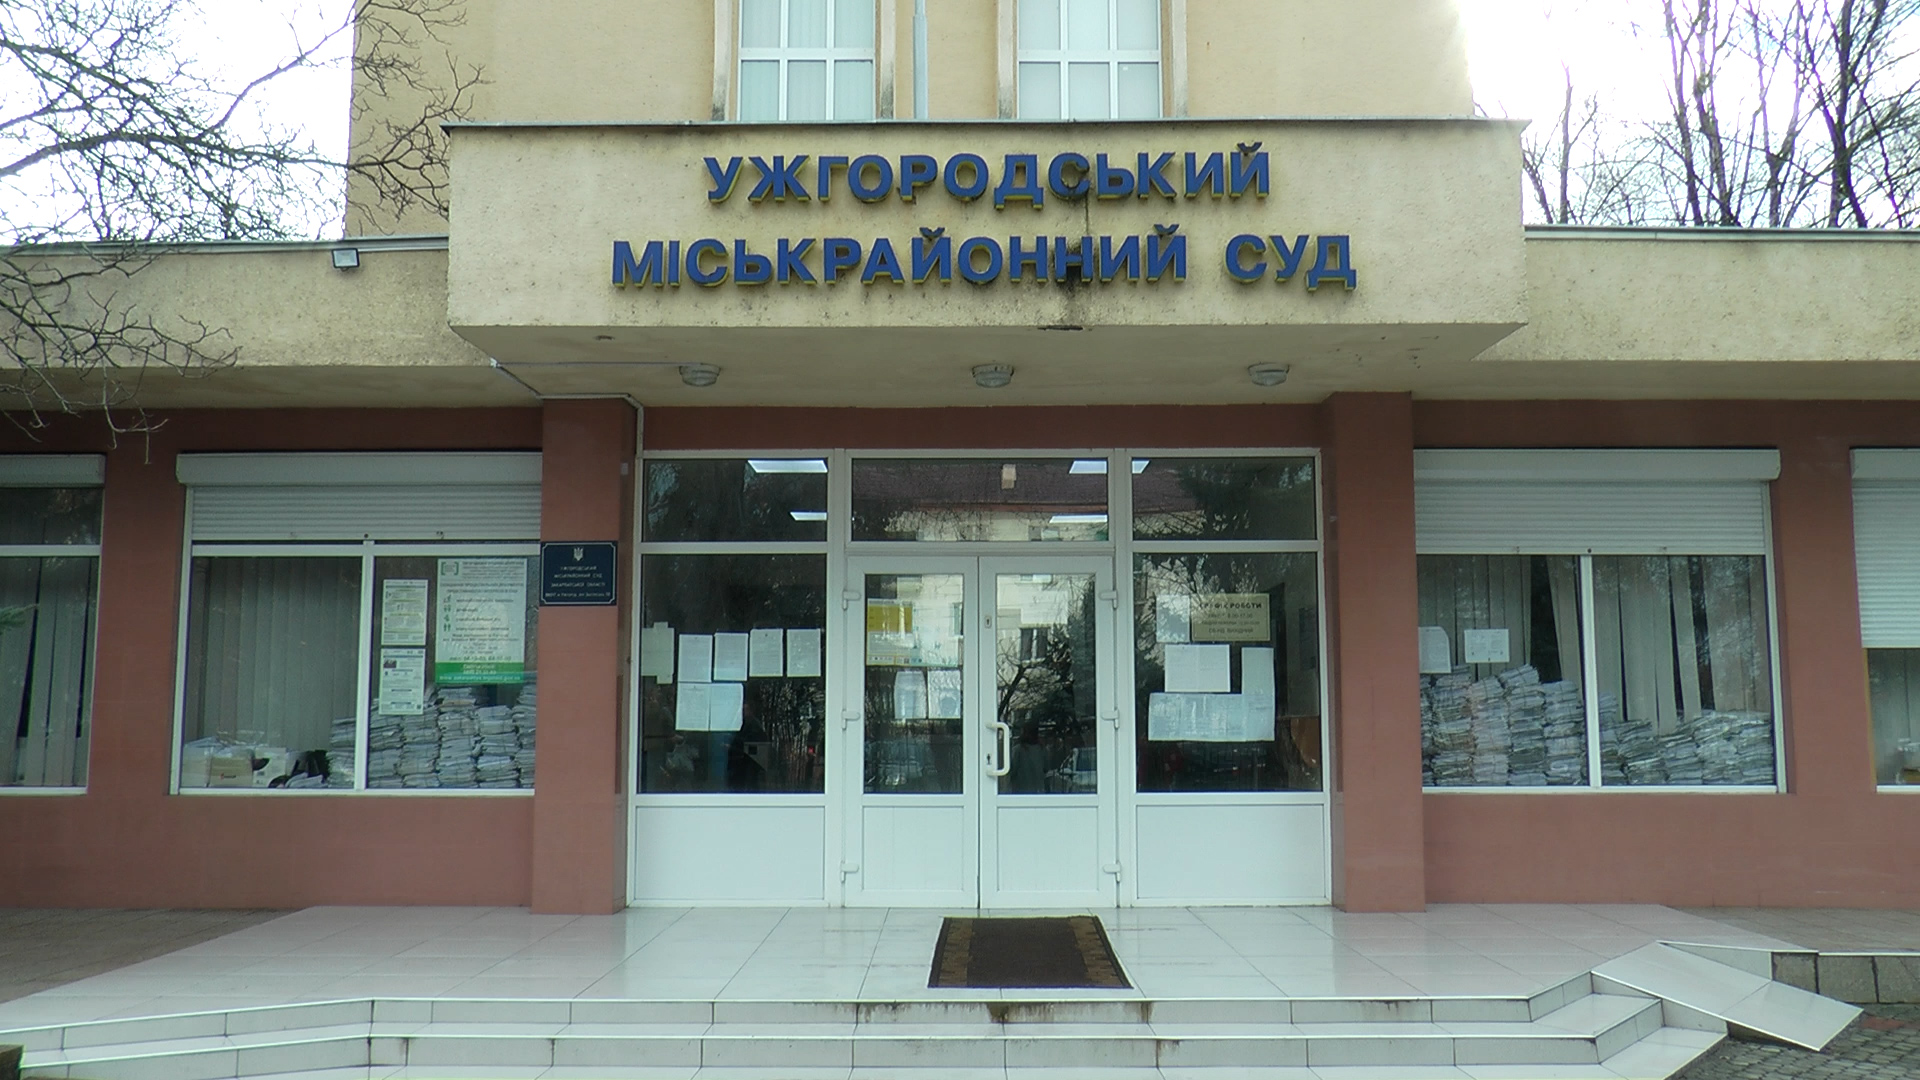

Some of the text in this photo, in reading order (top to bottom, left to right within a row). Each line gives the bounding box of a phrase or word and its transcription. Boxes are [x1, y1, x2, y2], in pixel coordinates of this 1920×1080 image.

[703, 142, 1270, 209] УЖГОРОДСЬКИЙ
[612, 224, 1357, 291] МІСЬКРАЙОННИЙ СУД
